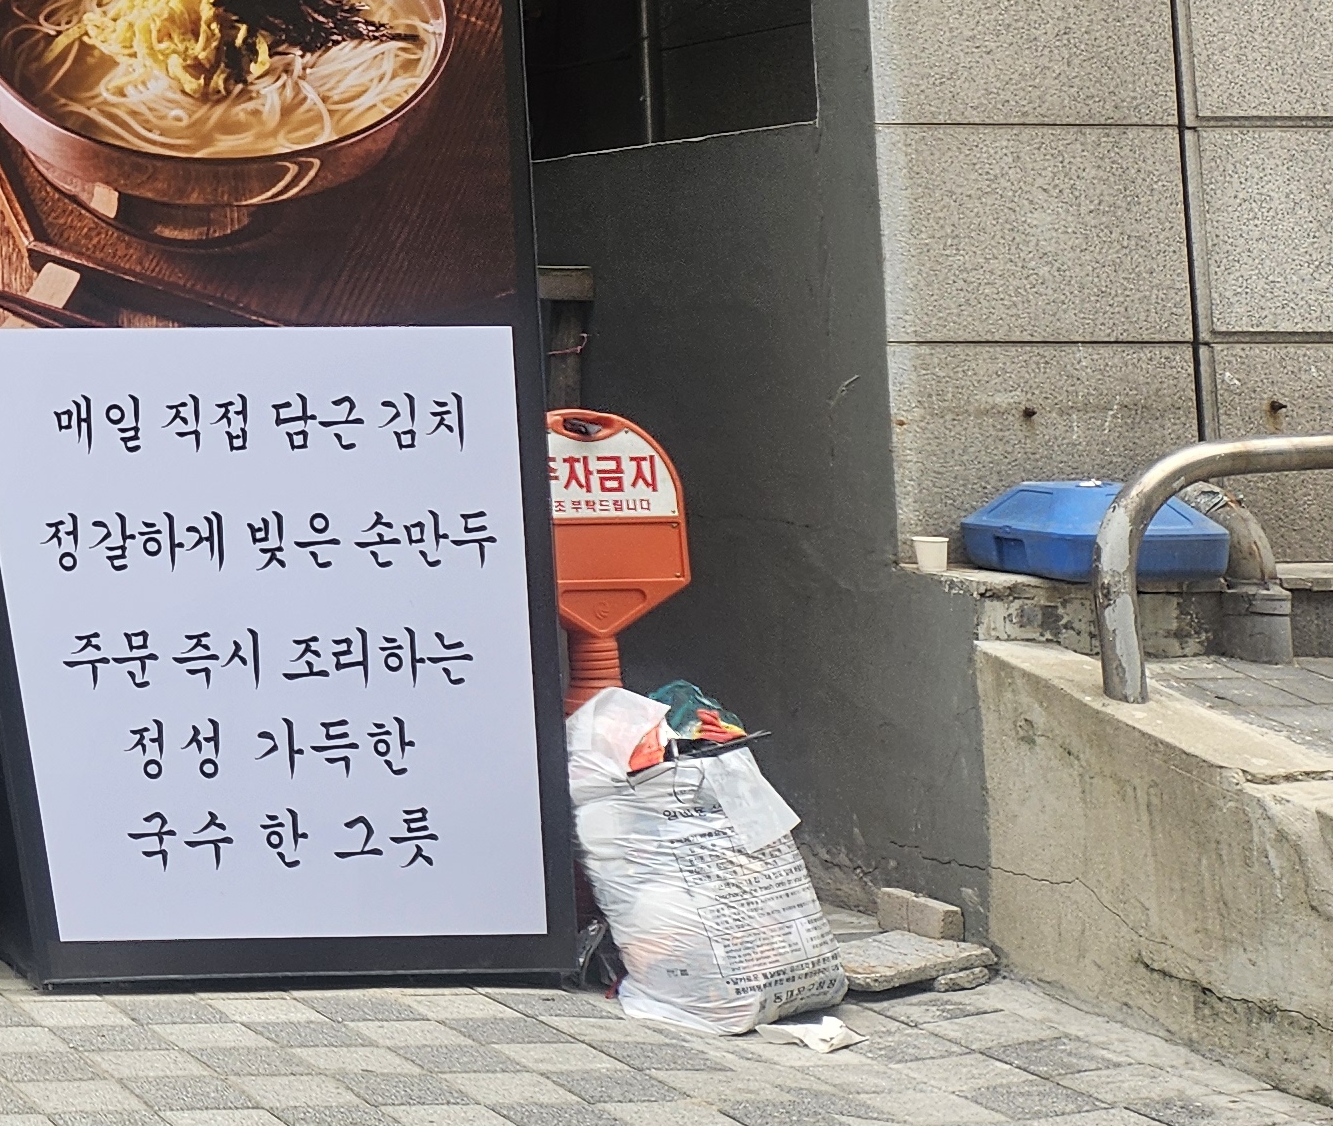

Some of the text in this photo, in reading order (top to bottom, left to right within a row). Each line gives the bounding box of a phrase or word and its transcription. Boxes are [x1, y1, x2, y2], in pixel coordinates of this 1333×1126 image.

[53, 393, 142, 453] 매일
[162, 393, 248, 453] 직접
[553, 498, 652, 513] 조 부탁드립니다
[41, 510, 225, 572] 정갈하게
[62, 626, 474, 690] 주문 즉시 조리하는
[124, 716, 416, 780] 정성 가득한
[127, 806, 439, 871] 국수 한 그릇
